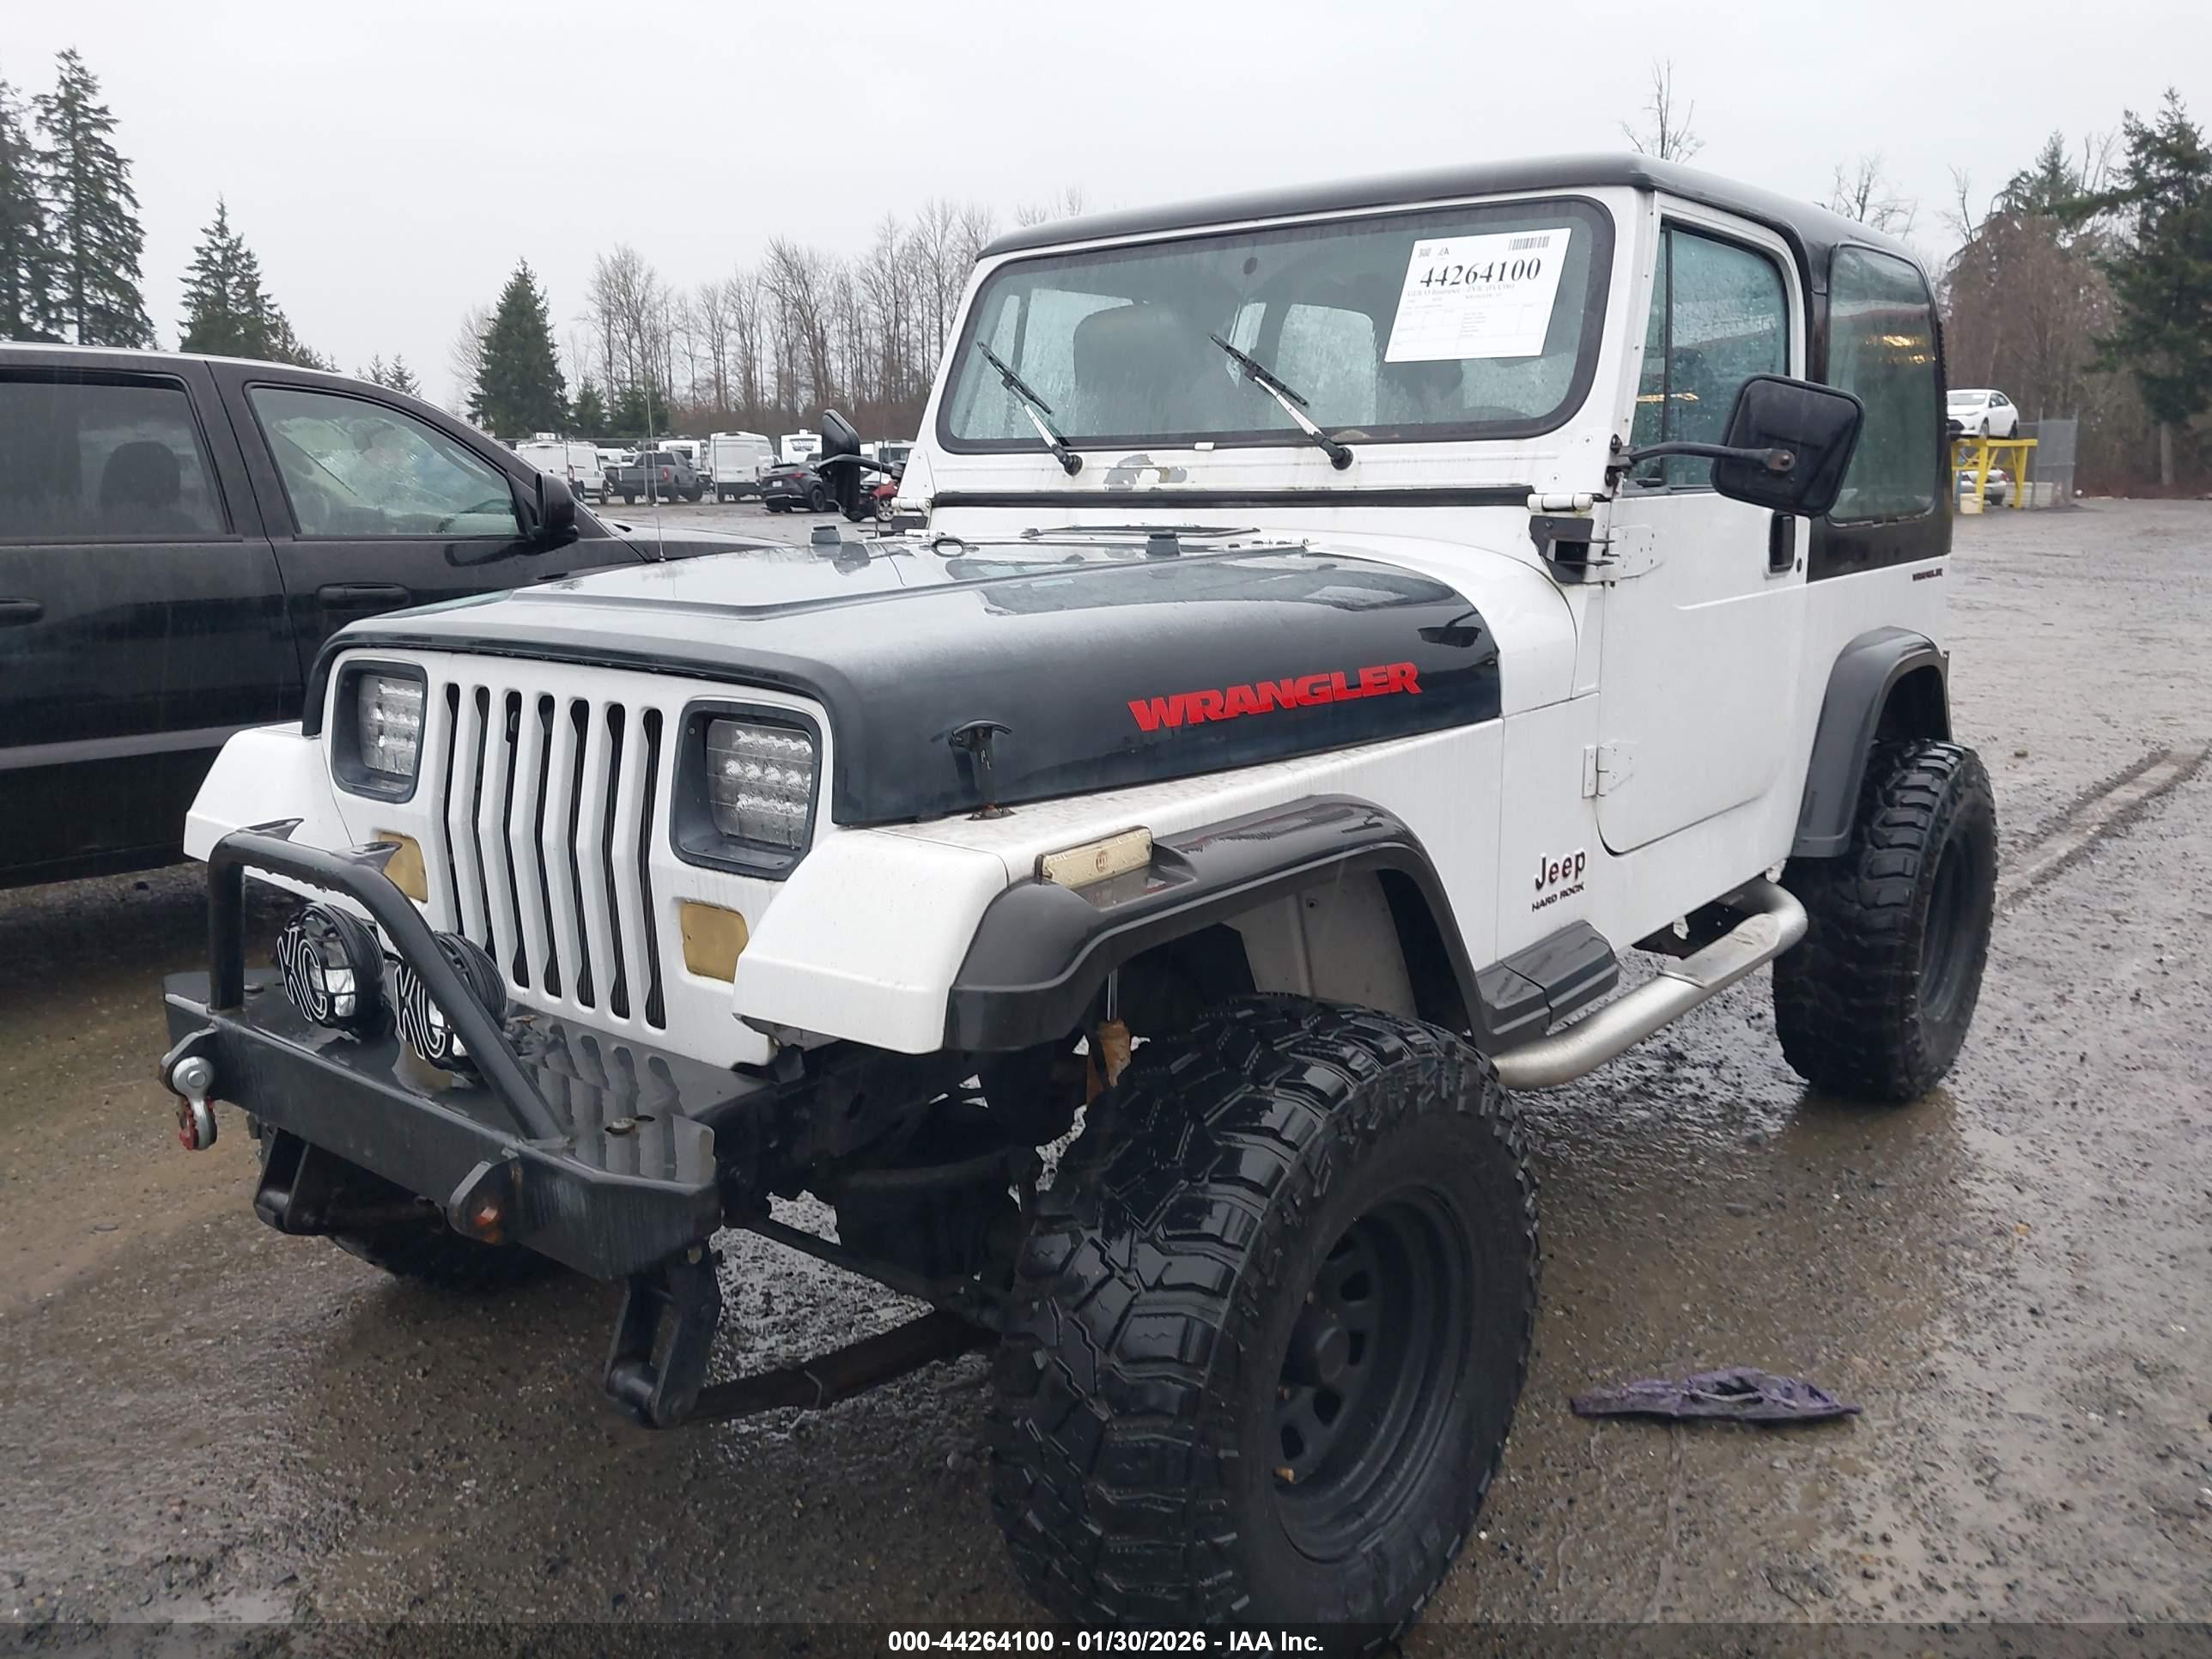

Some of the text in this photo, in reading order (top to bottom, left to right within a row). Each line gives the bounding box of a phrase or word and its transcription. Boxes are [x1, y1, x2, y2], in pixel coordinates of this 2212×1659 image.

[1420, 258, 1541, 288] 44264100
[1127, 661, 1422, 732] WRANGLER
[1534, 851, 1586, 891] Jeep
[1531, 882, 1584, 912] HARD ROCK
[276, 928, 329, 1023] KC
